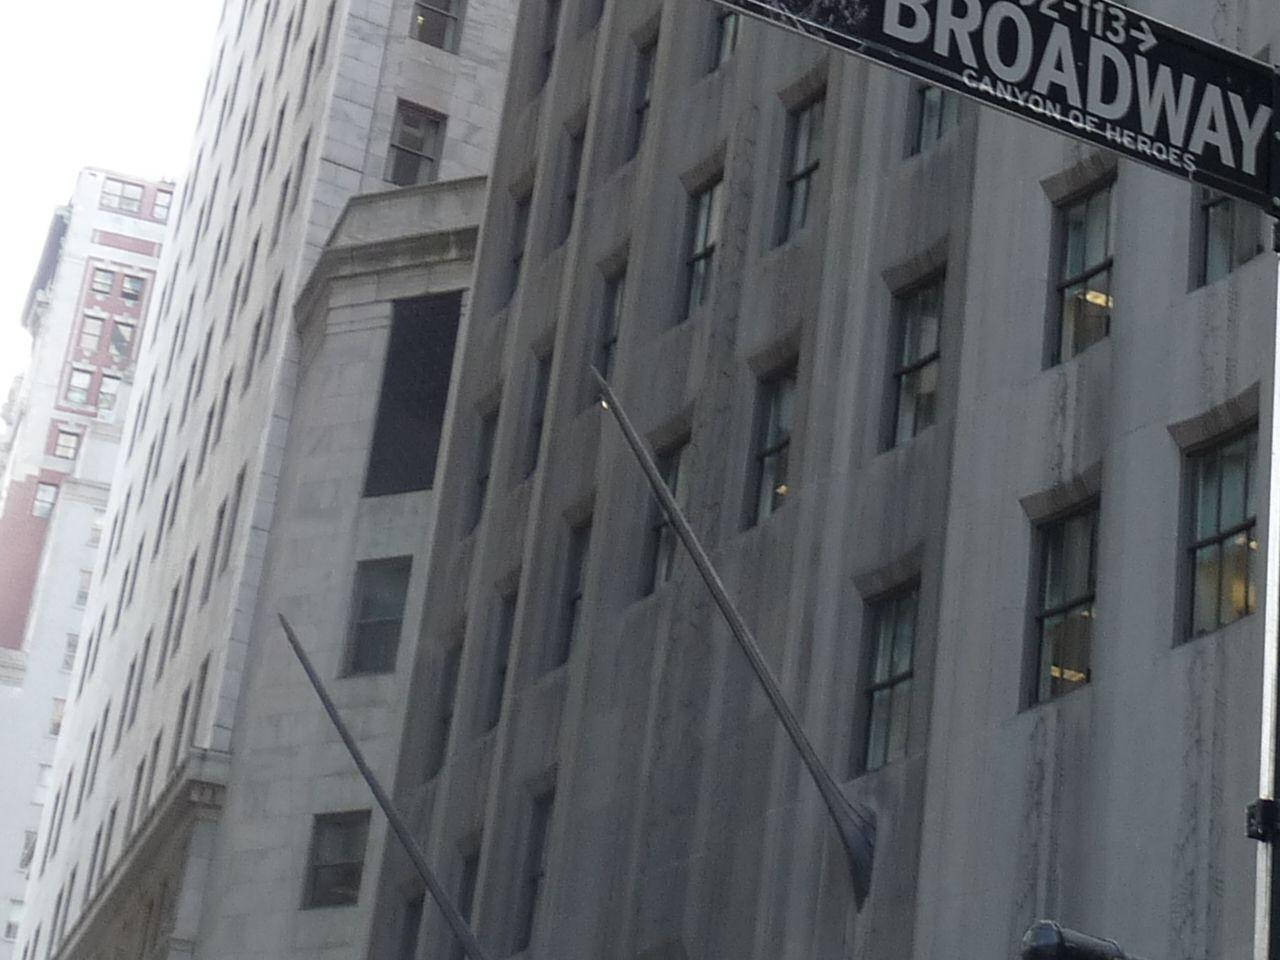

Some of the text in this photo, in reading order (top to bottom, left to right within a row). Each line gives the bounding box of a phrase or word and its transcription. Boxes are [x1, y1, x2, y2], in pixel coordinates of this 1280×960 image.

[962, 69, 1197, 172] CANYON OF HEROES
